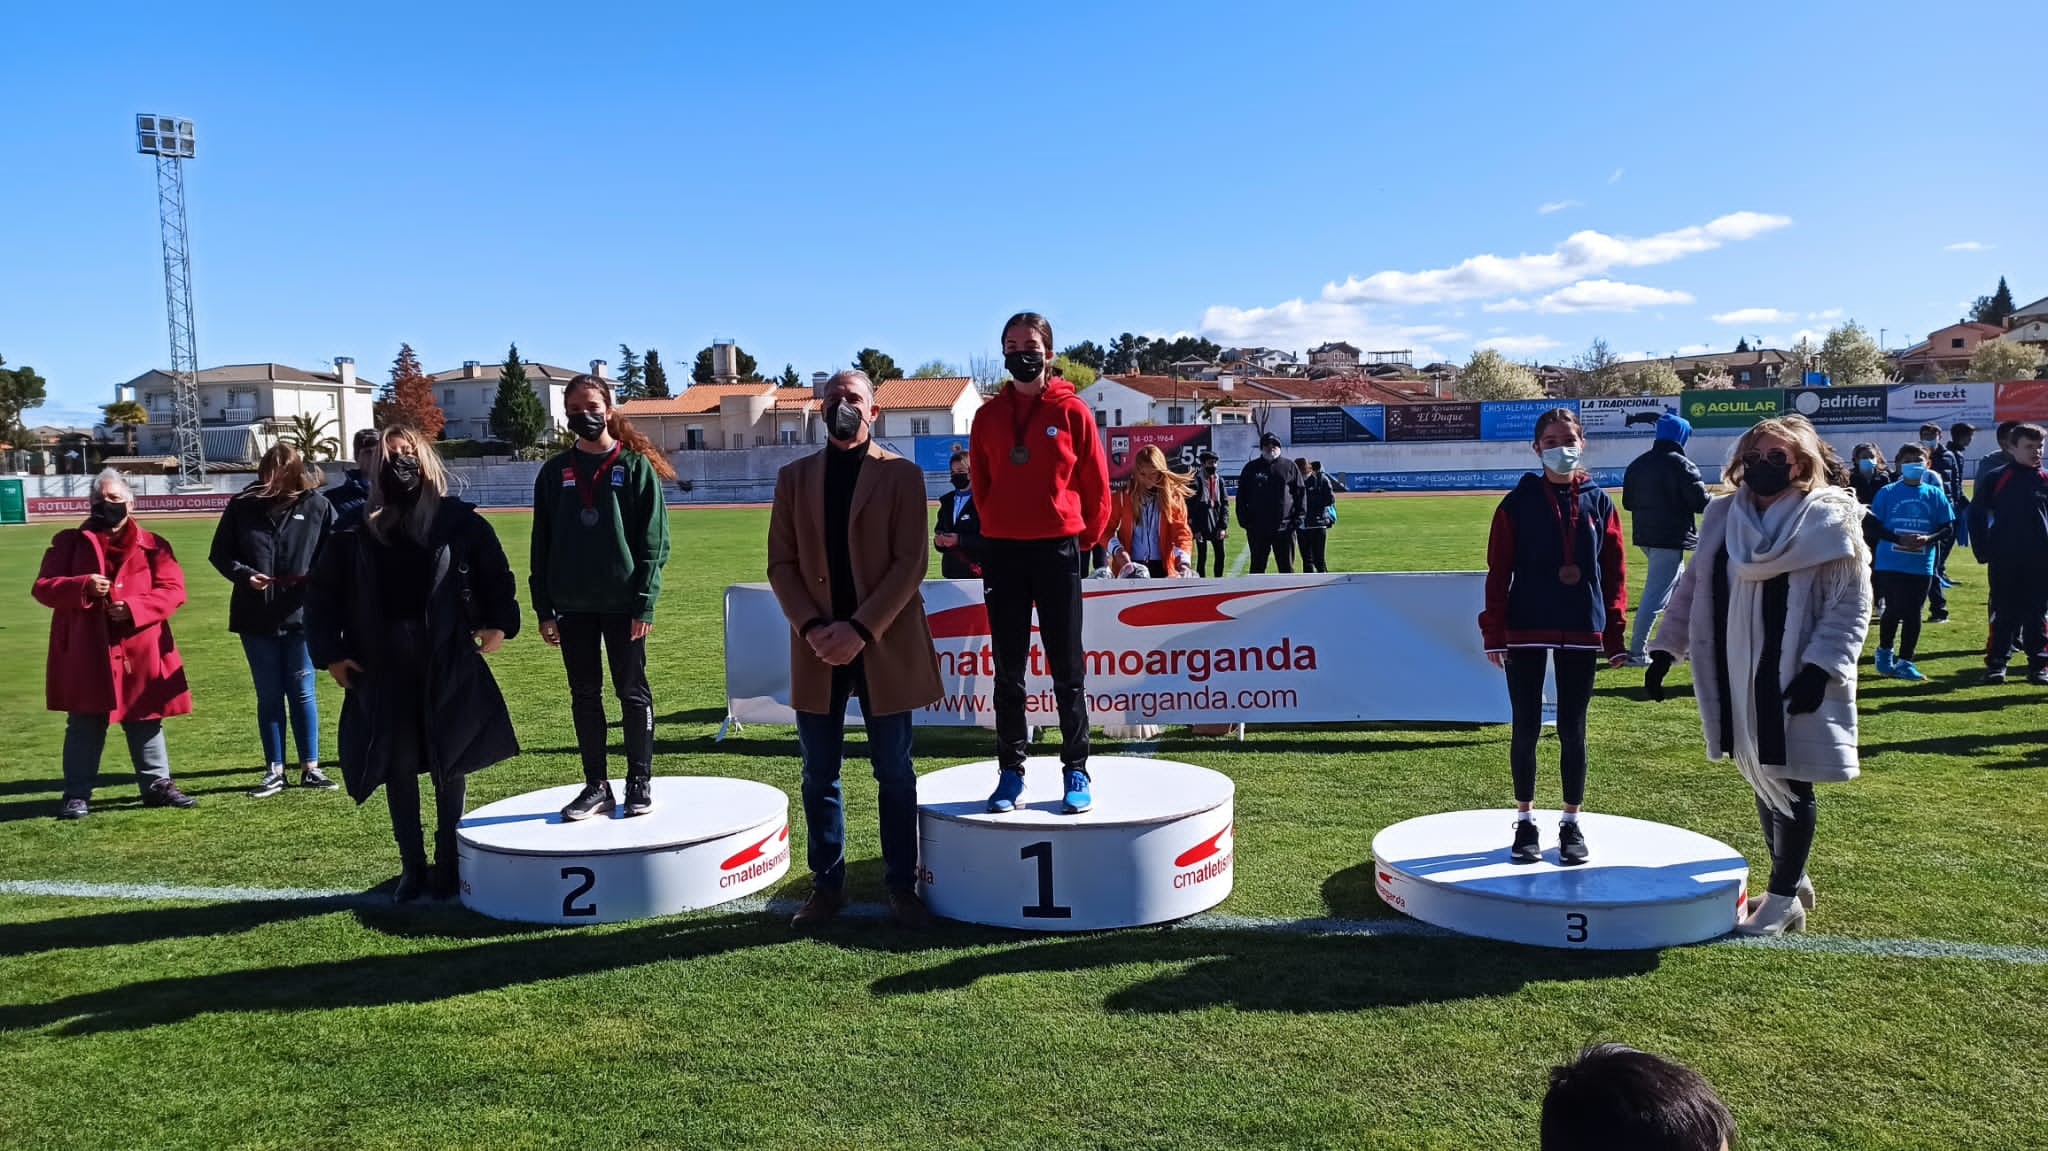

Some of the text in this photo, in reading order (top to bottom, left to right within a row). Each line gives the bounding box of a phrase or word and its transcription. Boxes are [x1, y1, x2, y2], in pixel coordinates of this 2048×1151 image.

[1914, 388, 1966, 399] Iberext
[1582, 398, 1661, 409] LA TRADICIONAL
[1707, 401, 1776, 412] AGUILAR
[1821, 394, 1880, 408] adriferr
[1432, 411, 1464, 424] Duque
[1020, 841, 1072, 919] 1
[560, 866, 597, 917] 2
[1566, 912, 1589, 943] 3
